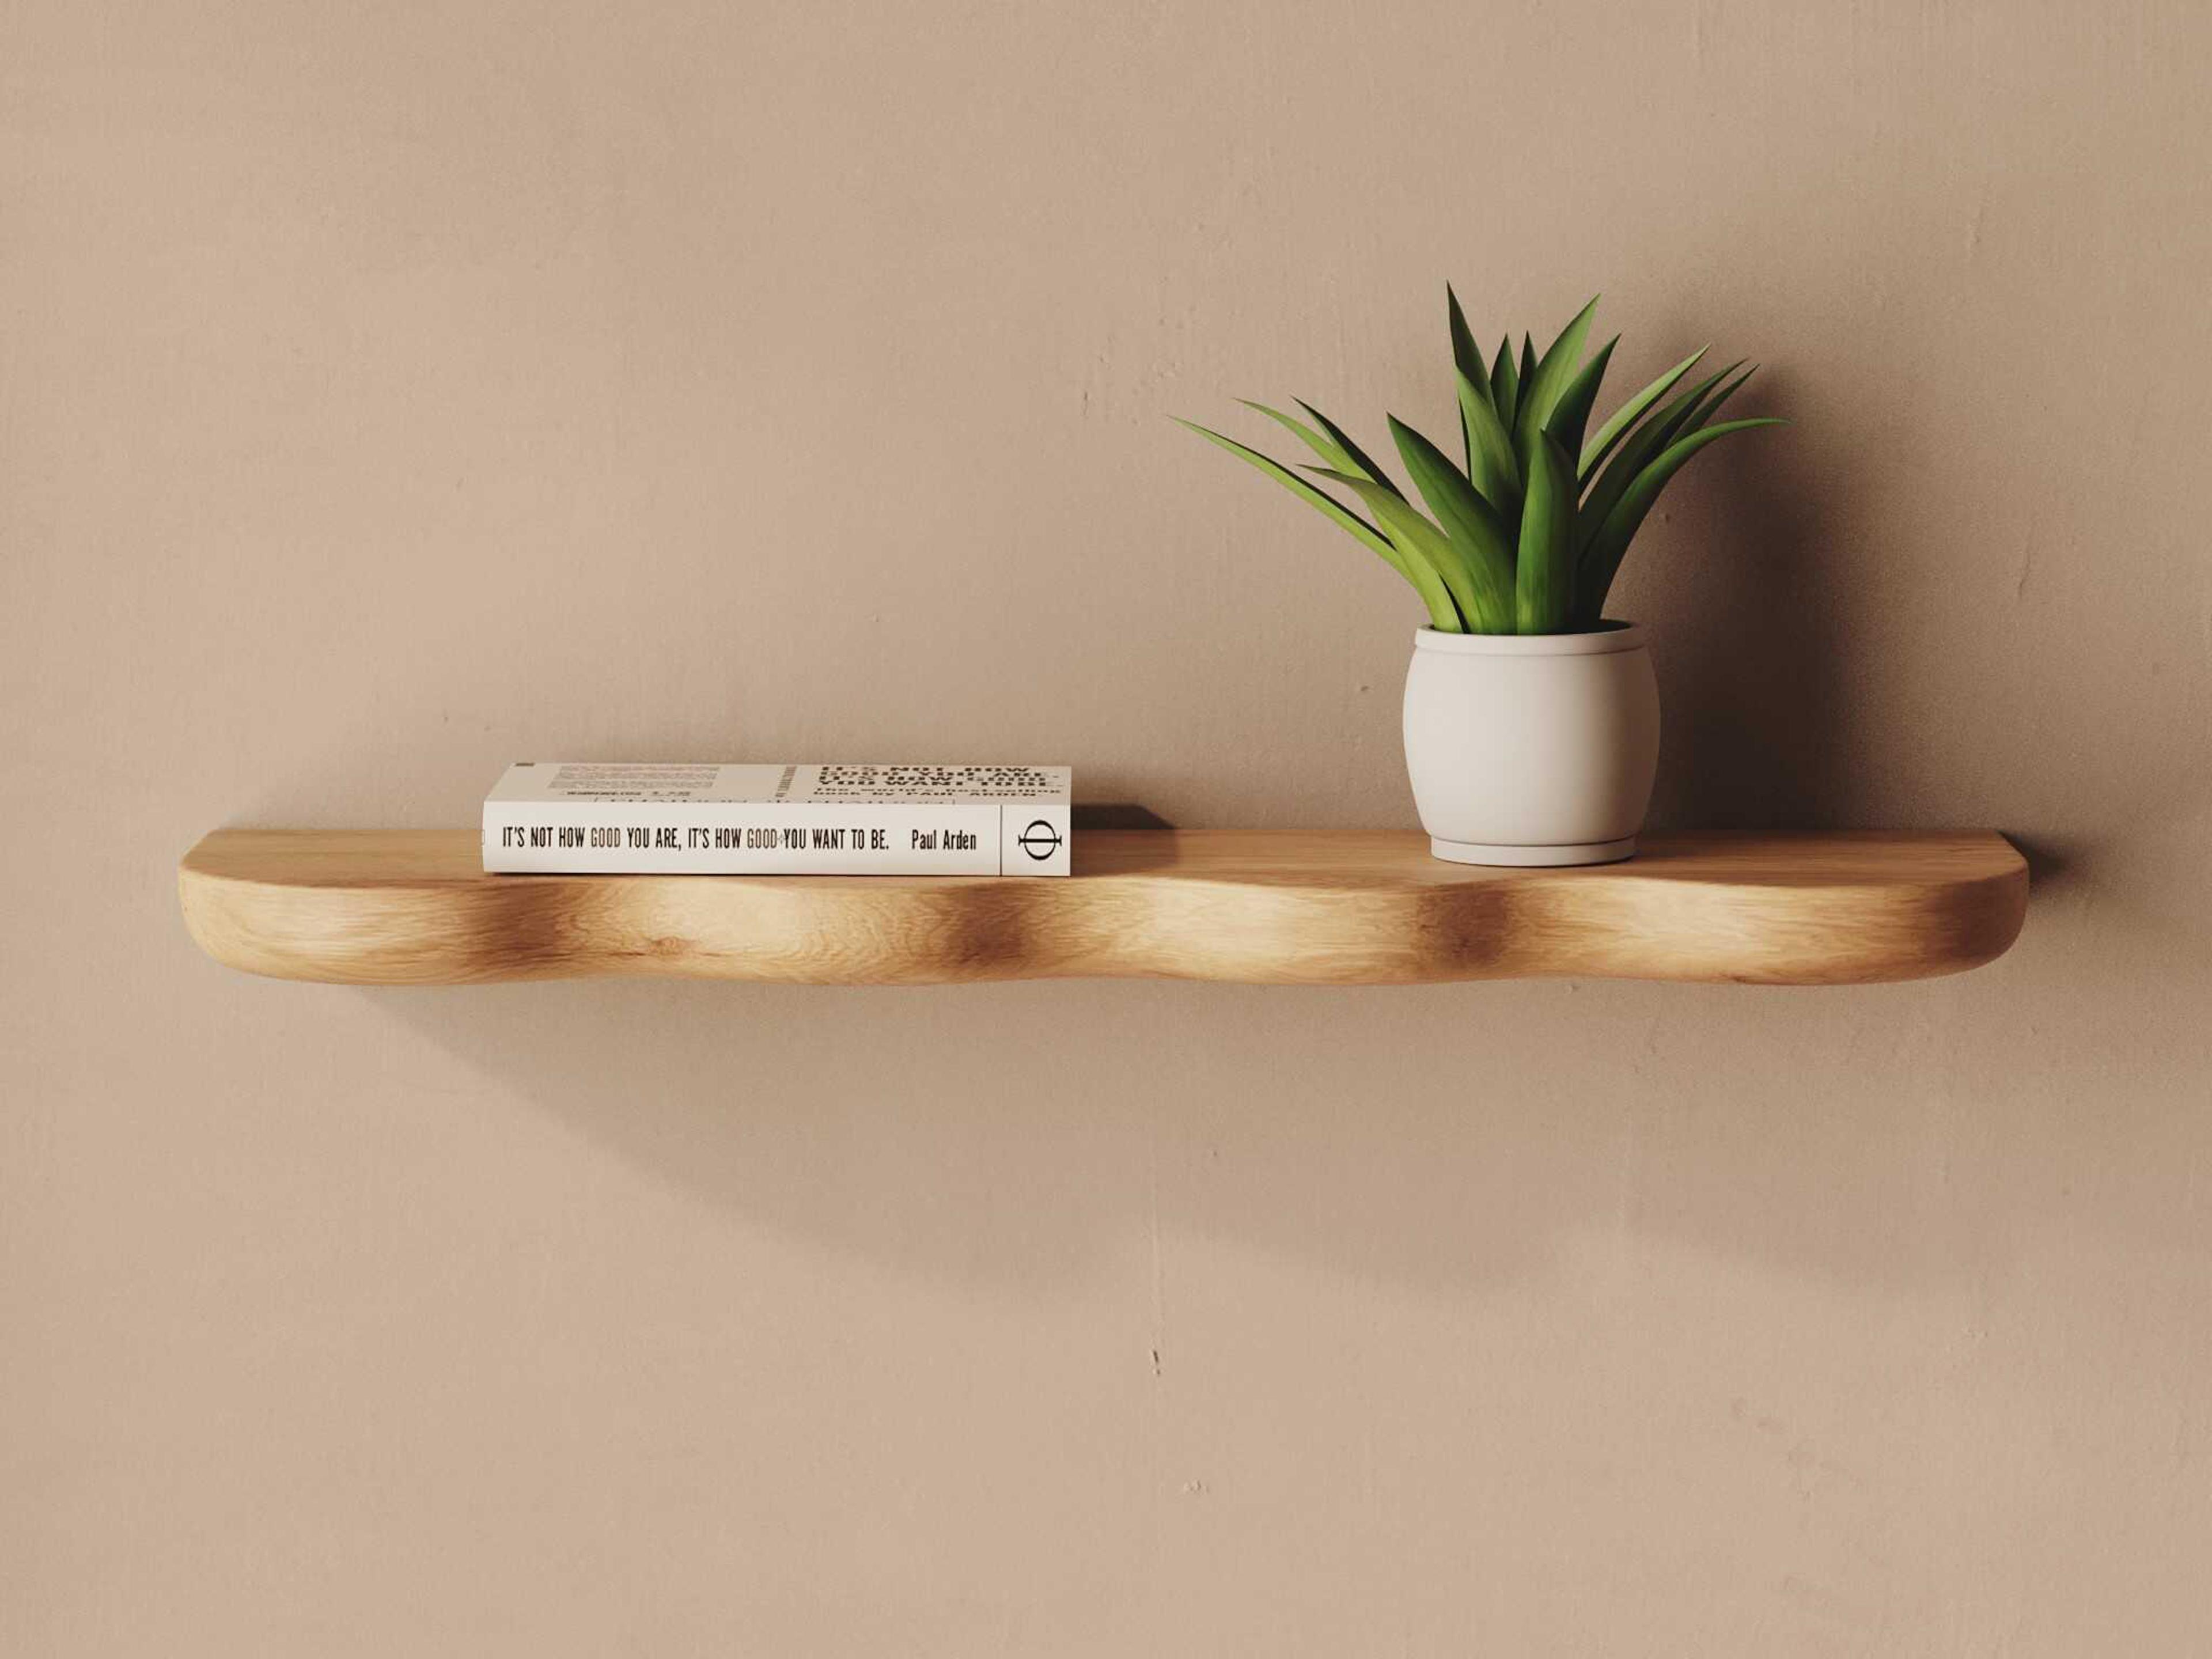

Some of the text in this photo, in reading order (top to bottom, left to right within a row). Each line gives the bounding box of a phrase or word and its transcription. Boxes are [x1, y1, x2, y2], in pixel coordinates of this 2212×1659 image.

[503, 827, 976, 852] IT'S NOT HOW GOOD YOU ARE, IT'S HOW GOOD YOU WANT TO BE. Paul Arden
